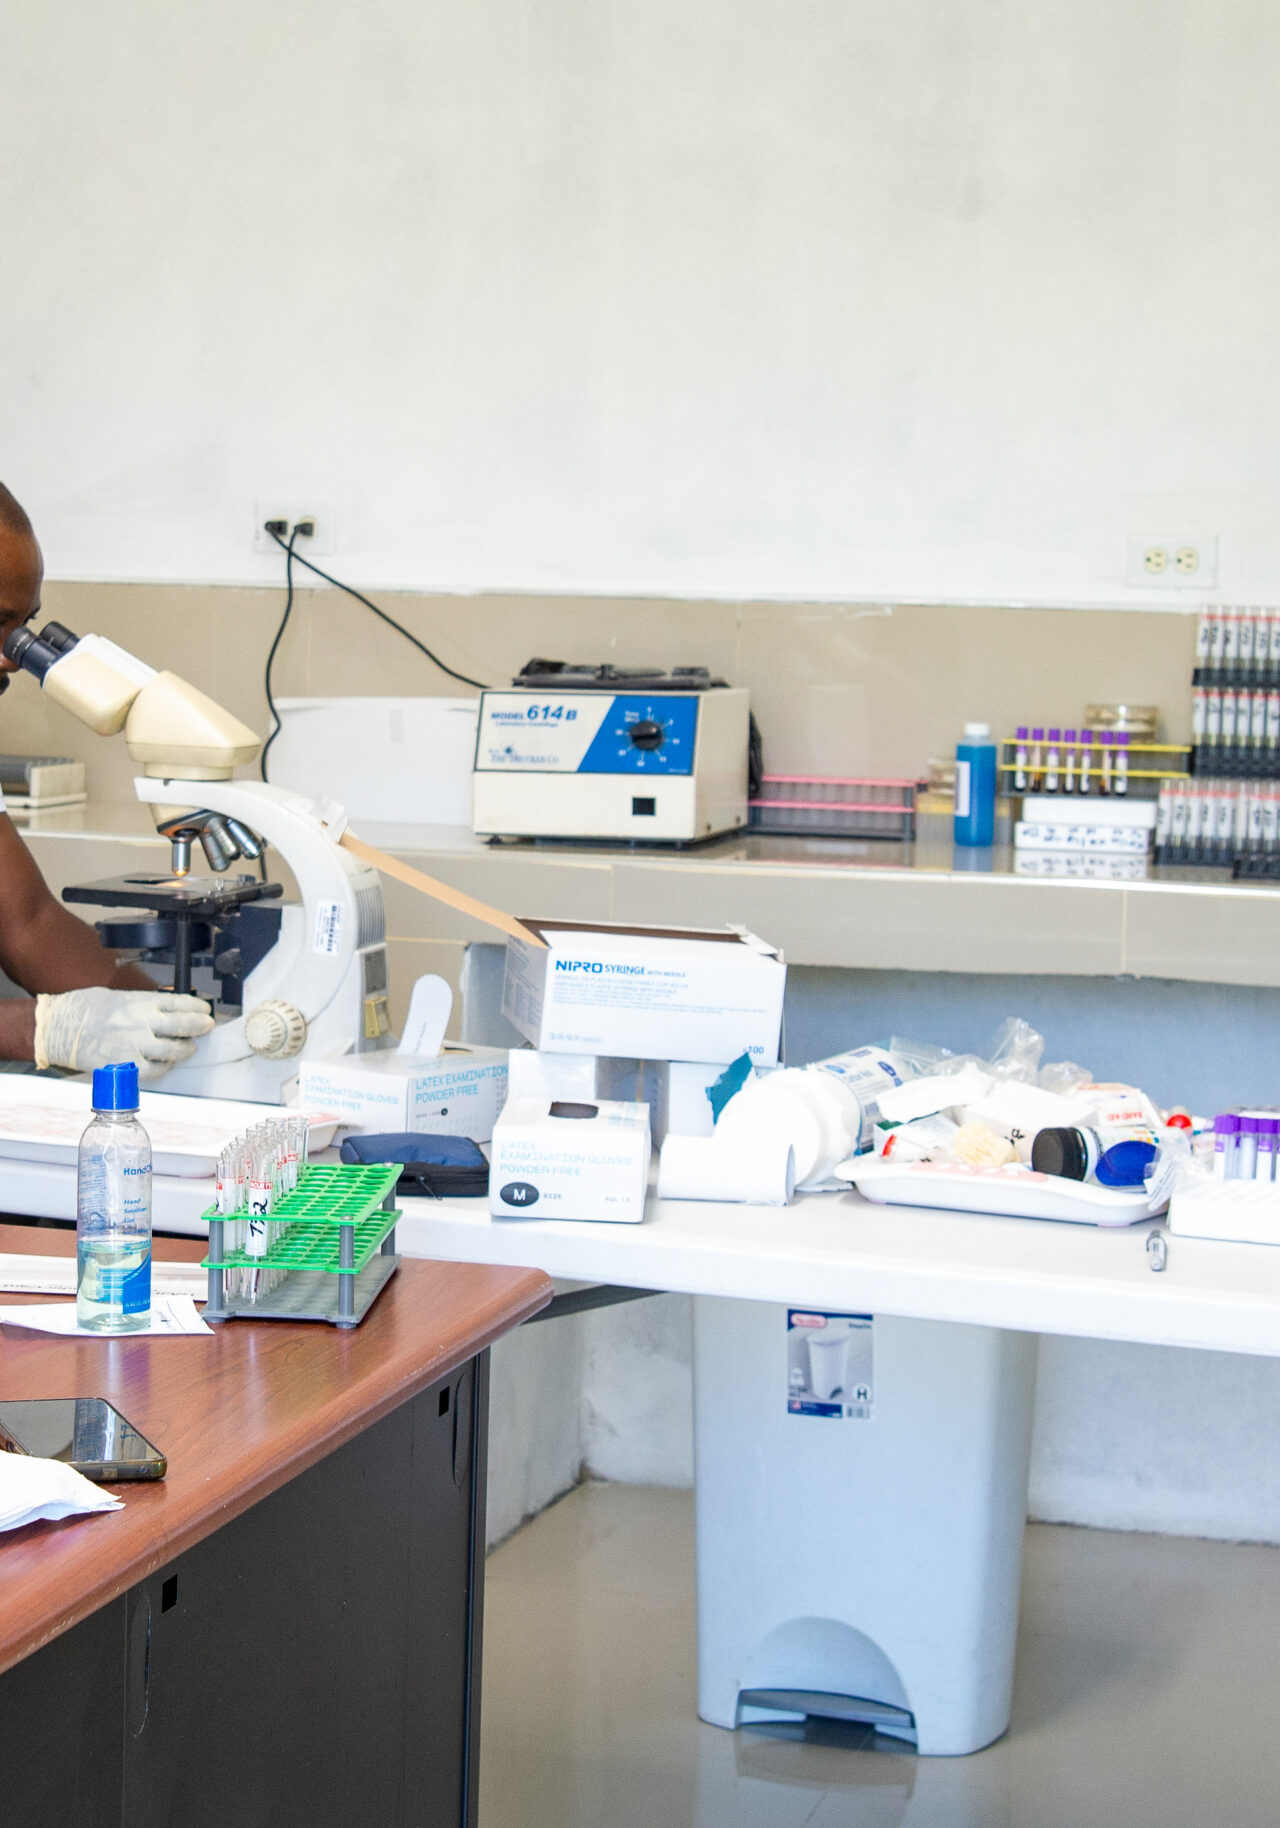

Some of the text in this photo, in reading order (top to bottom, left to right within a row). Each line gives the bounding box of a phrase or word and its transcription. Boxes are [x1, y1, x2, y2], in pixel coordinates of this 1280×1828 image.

[491, 705, 579, 721] MODEL 614 B
[555, 959, 604, 975] NIPRO
[604, 963, 646, 976] SYRINGE
[304, 1074, 329, 1085] LATEX
[416, 1065, 508, 1090] LATEX EXAMINATION
[304, 1084, 399, 1105] EXAMINATION GLOVES
[416, 1083, 479, 1104] POWDER FREE
[304, 1095, 362, 1111] POWDER FREE
[500, 1141, 536, 1151] LATEX
[500, 1151, 633, 1166] EXAMINATION GLOVES
[500, 1164, 581, 1177] POWDER FREE
[514, 1188, 526, 1201] M
[856, 1388, 868, 1401] H
